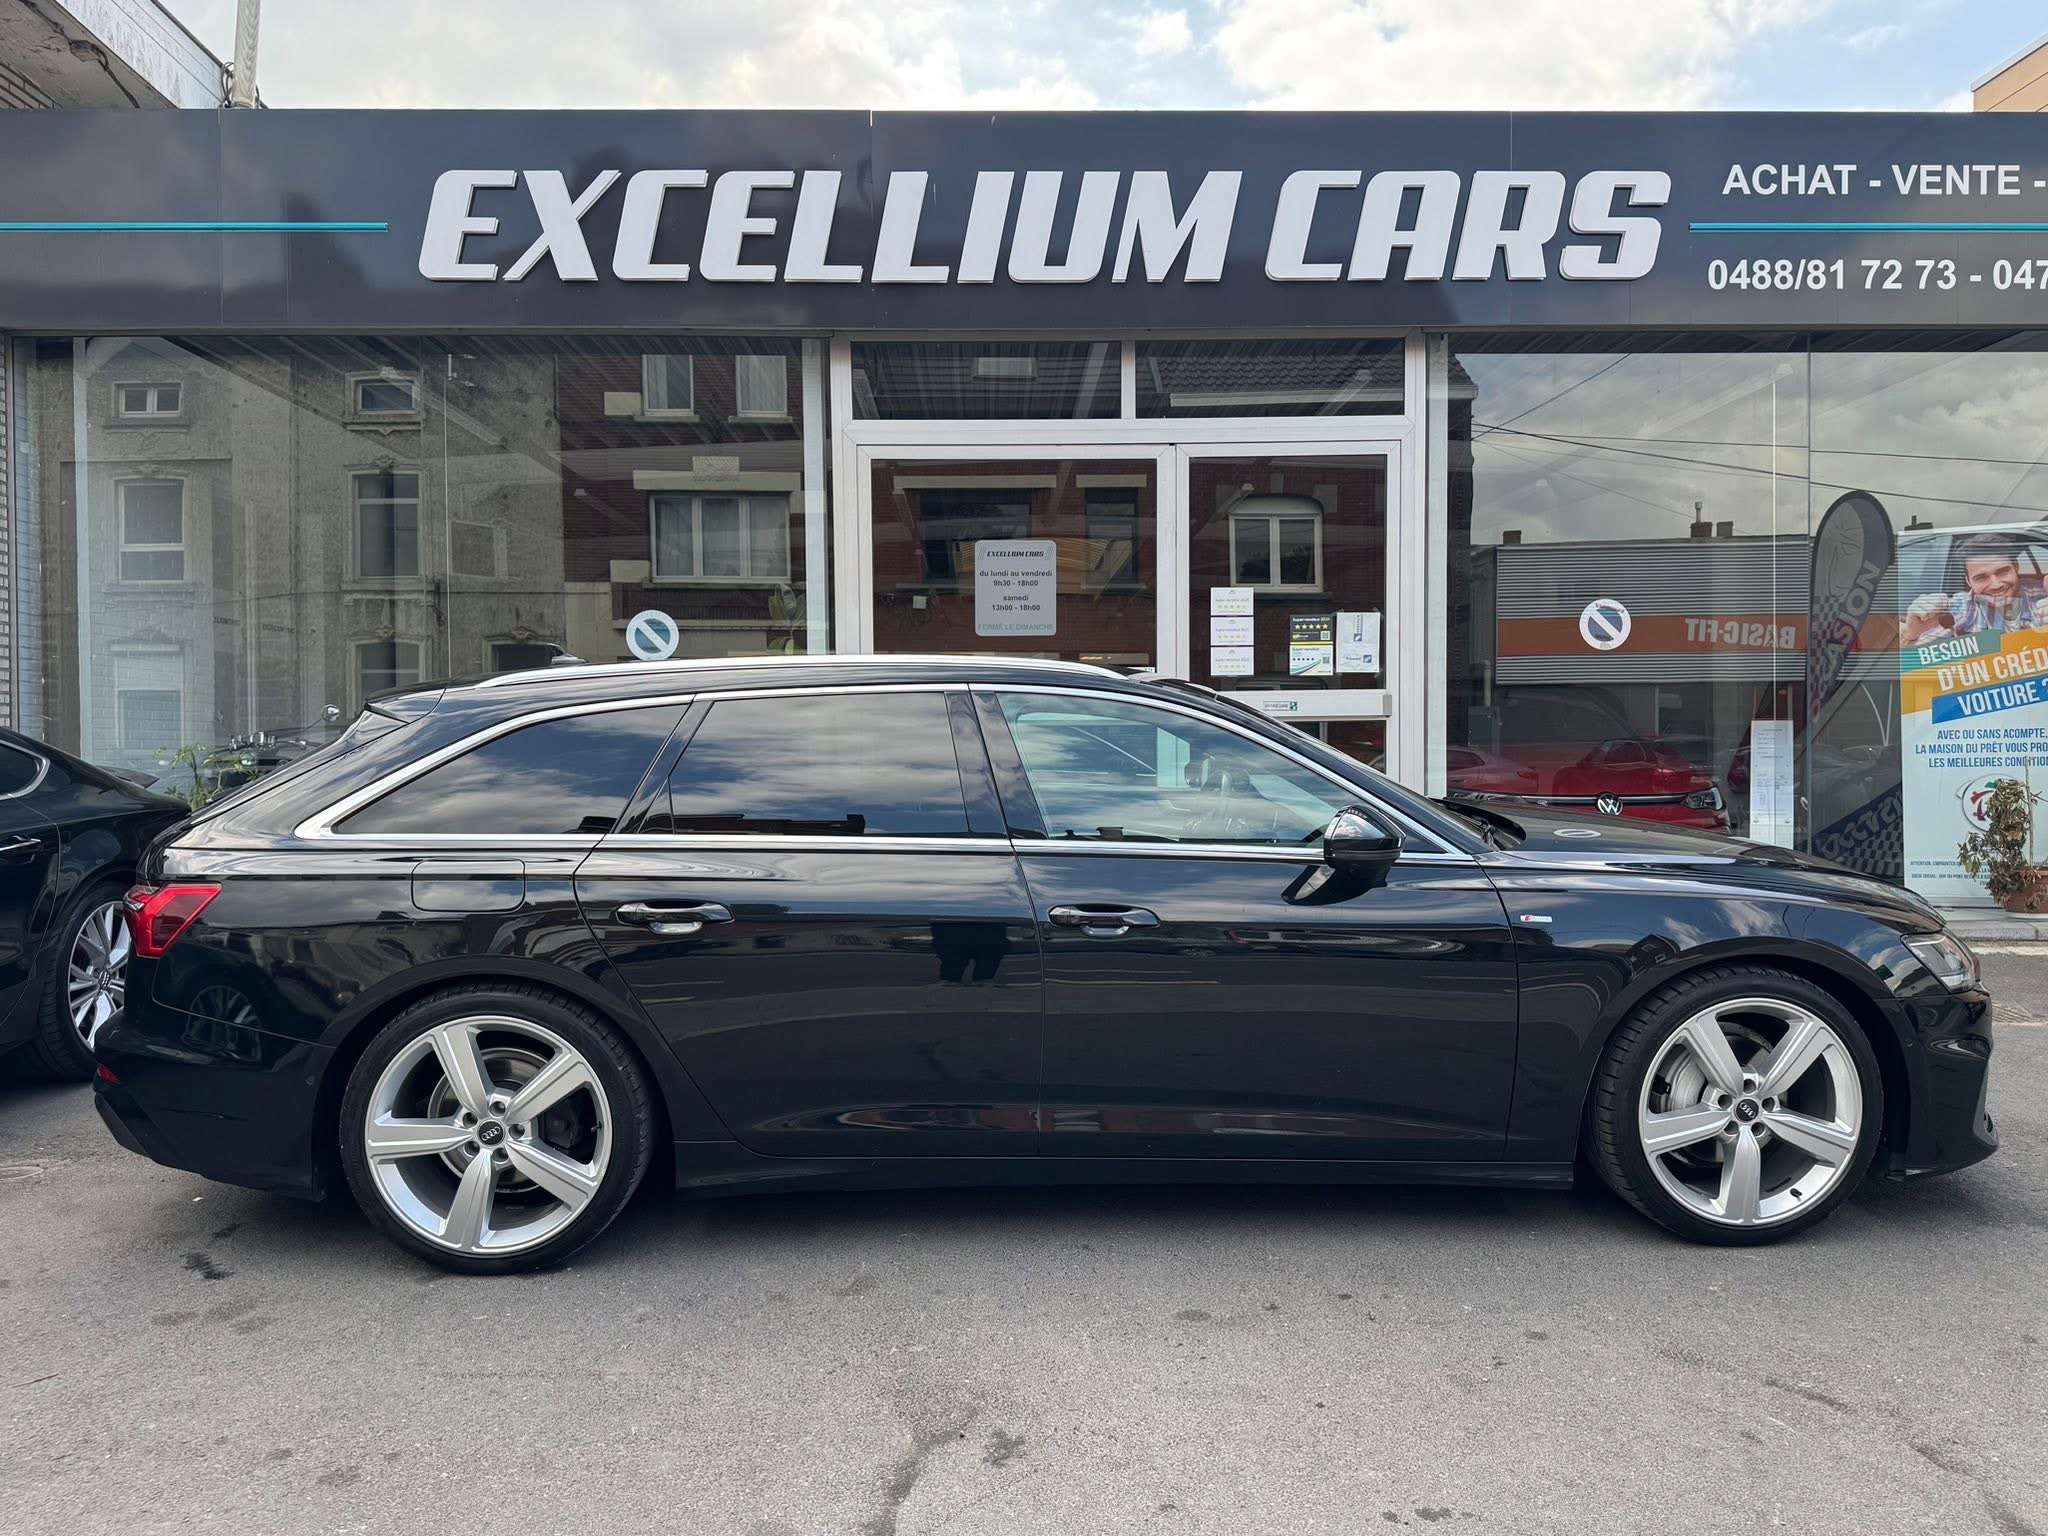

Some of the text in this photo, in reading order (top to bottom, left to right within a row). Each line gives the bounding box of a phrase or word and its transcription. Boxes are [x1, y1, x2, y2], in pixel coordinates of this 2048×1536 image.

[1722, 164, 2046, 195] ACHAT - VENTE -
[418, 169, 1672, 283] EXCELLIUM CARS
[1708, 258, 1844, 290] 0488/81
[1861, 259, 1903, 290] 72
[1915, 259, 1957, 290] 73
[1969, 274, 1982, 283] -
[1917, 635, 1980, 665] BESOIN
[1937, 645, 2048, 692] D'UN CRÉD
[1957, 681, 2041, 716] VOITURE
[1915, 744, 1927, 754] LA
[1929, 743, 1963, 754] MAISON
[1966, 743, 1978, 753] DU
[1980, 741, 2002, 753] PRÊT
[2005, 742, 2028, 752] VOUS
[1937, 728, 2048, 740] AVEC OU SANS ACOMPTE,
[1928, 757, 1945, 767] LES
[1947, 757, 2003, 767] MEILLEURES
